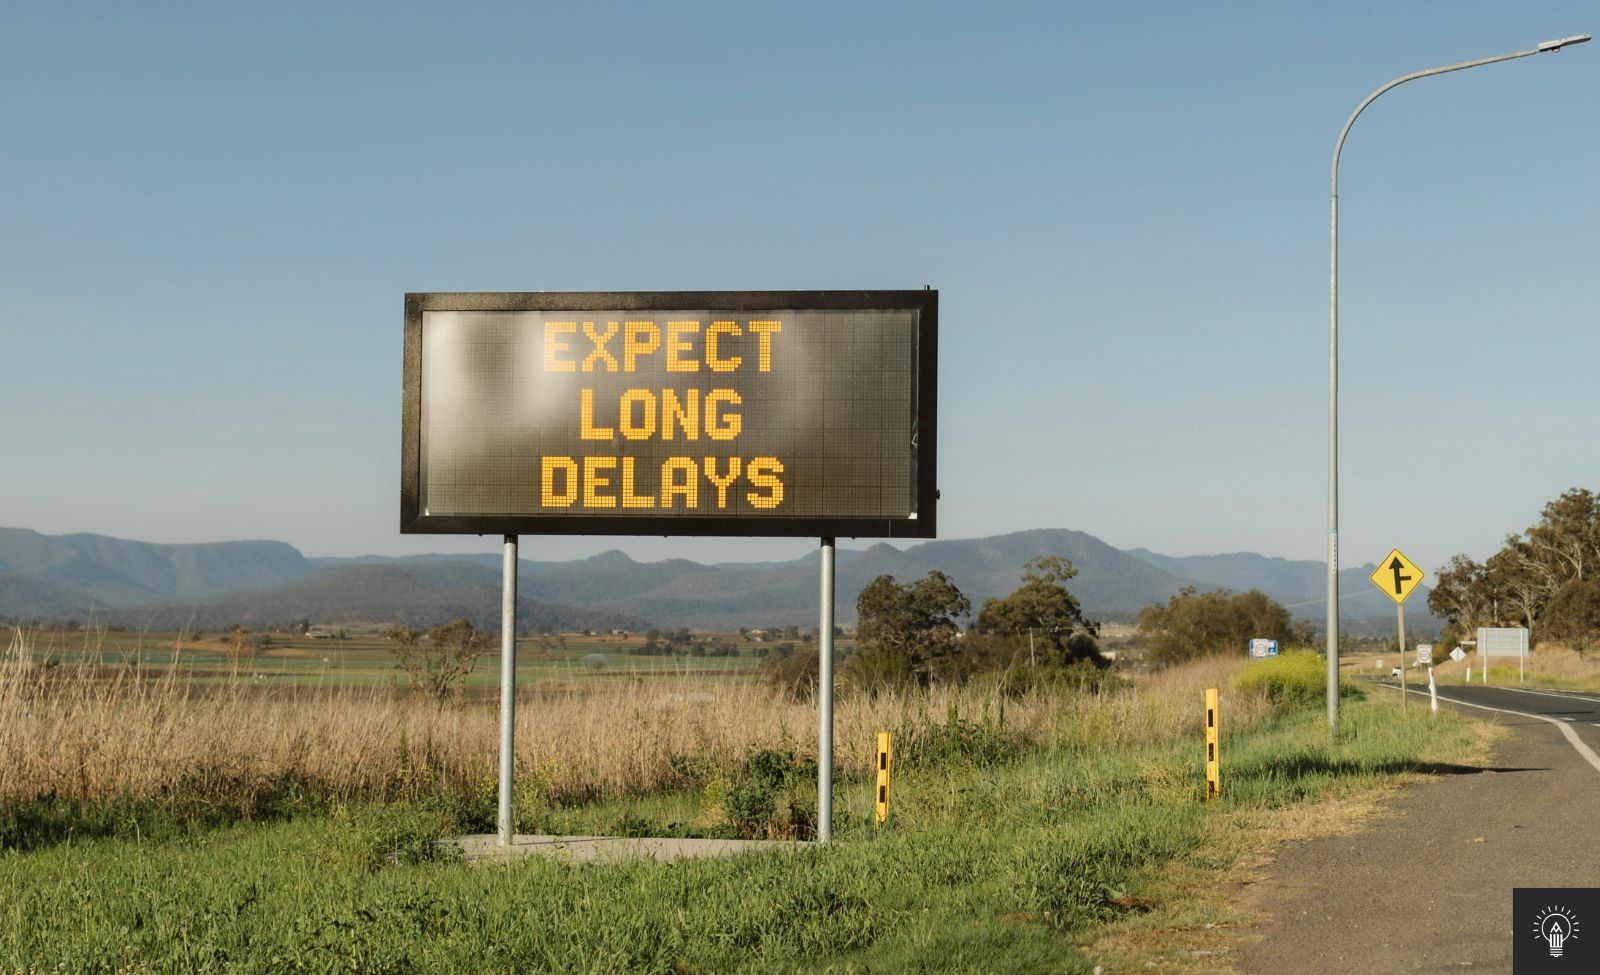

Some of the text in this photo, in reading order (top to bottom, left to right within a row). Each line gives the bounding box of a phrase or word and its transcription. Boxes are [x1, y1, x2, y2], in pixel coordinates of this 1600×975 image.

[542, 320, 782, 372] EXPECT
[580, 387, 742, 440] LONG
[541, 456, 784, 508] DELAYS
